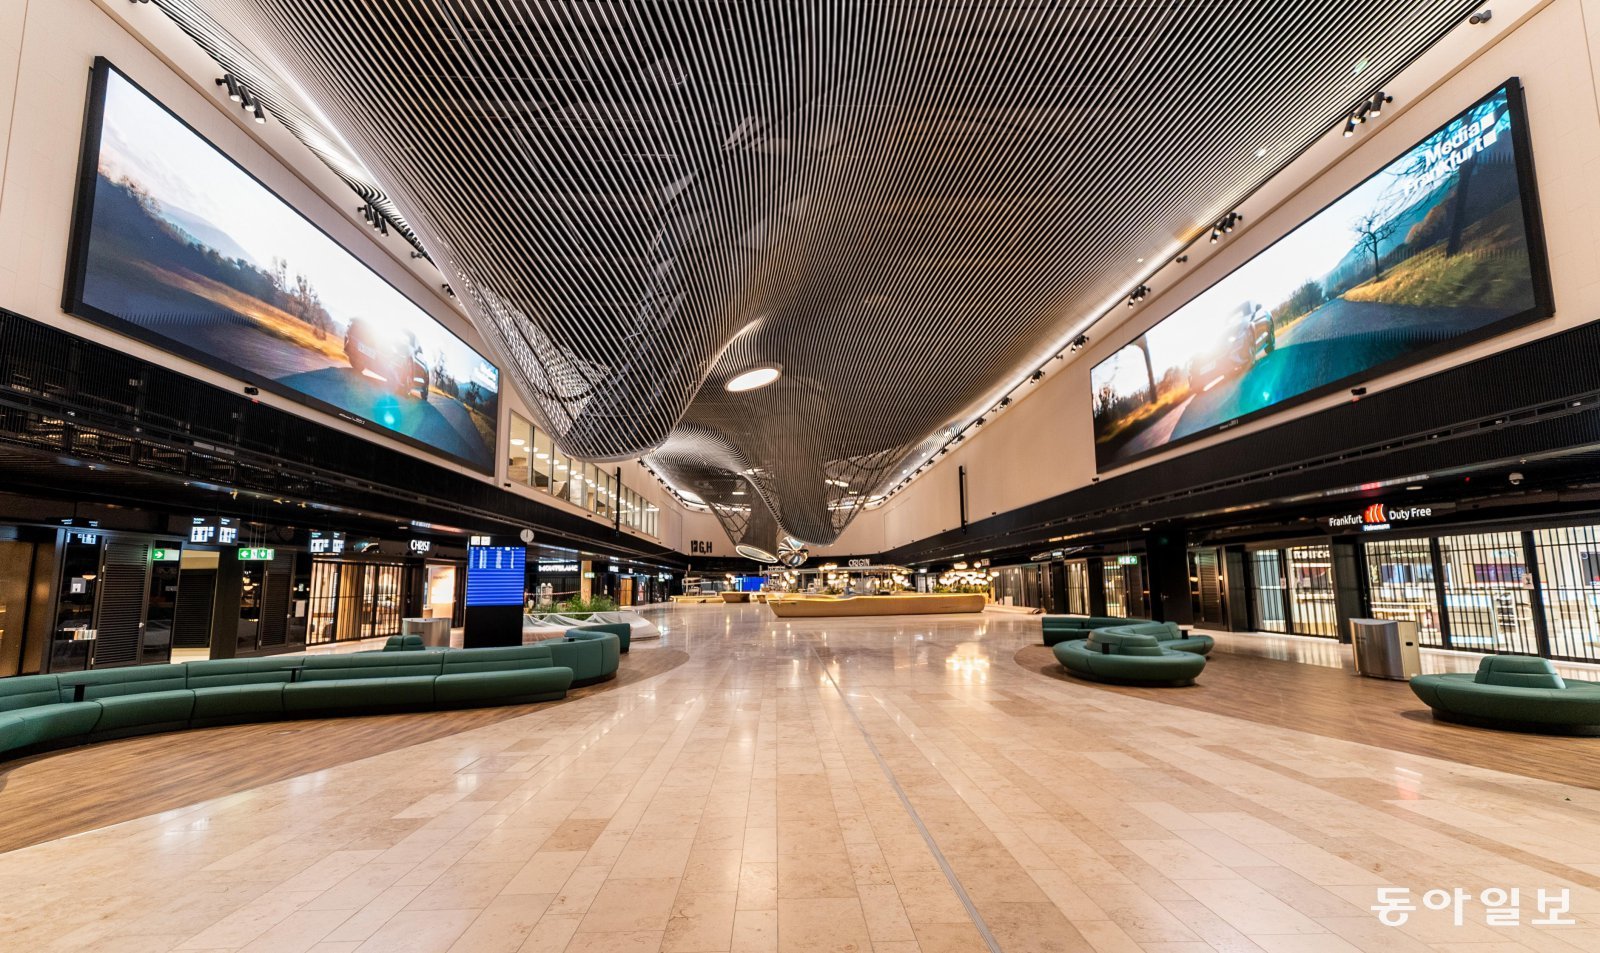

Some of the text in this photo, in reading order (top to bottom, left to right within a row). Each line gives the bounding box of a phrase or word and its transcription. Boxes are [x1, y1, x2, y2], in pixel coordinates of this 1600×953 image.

[1424, 123, 1480, 169] Media
[1329, 507, 1432, 527] Frankfurt Duty Free
[410, 539, 431, 551] CHRIST
[848, 558, 870, 567] ORIGIN
